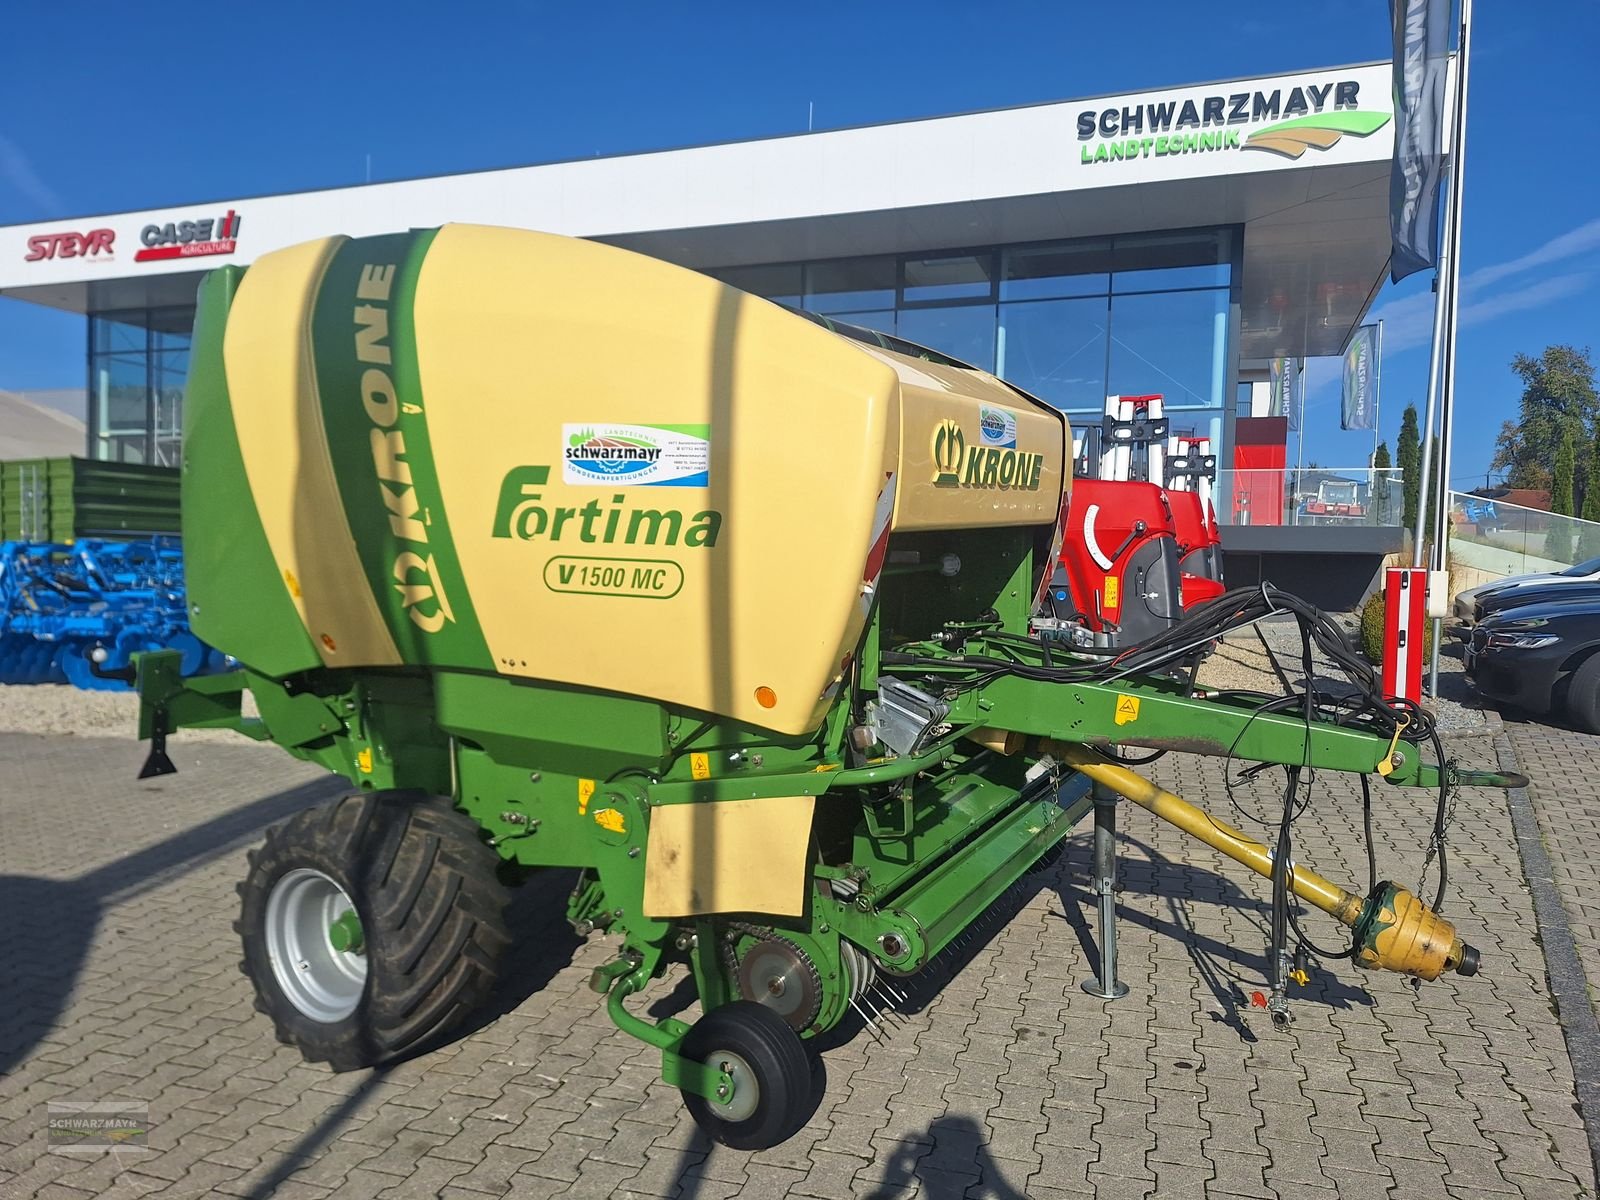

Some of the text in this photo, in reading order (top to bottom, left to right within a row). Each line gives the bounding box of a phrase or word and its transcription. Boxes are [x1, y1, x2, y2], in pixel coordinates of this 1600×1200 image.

[1077, 80, 1361, 140] SCHWARZMAYR
[1081, 129, 1241, 164] LANDTECHNIK
[25, 228, 116, 262] STEYR
[140, 218, 214, 247] CASE
[180, 240, 233, 256] AGRICULTURE
[354, 264, 428, 543] KRONE
[604, 428, 658, 443] LANDTECHNIK
[565, 444, 662, 462] schwarzmayr
[963, 446, 1043, 490] KRONE
[567, 464, 659, 481] SONDERANFERTIGUNGEN
[492, 465, 722, 548] Fortima
[580, 566, 625, 588] 1500
[630, 568, 667, 590] MC
